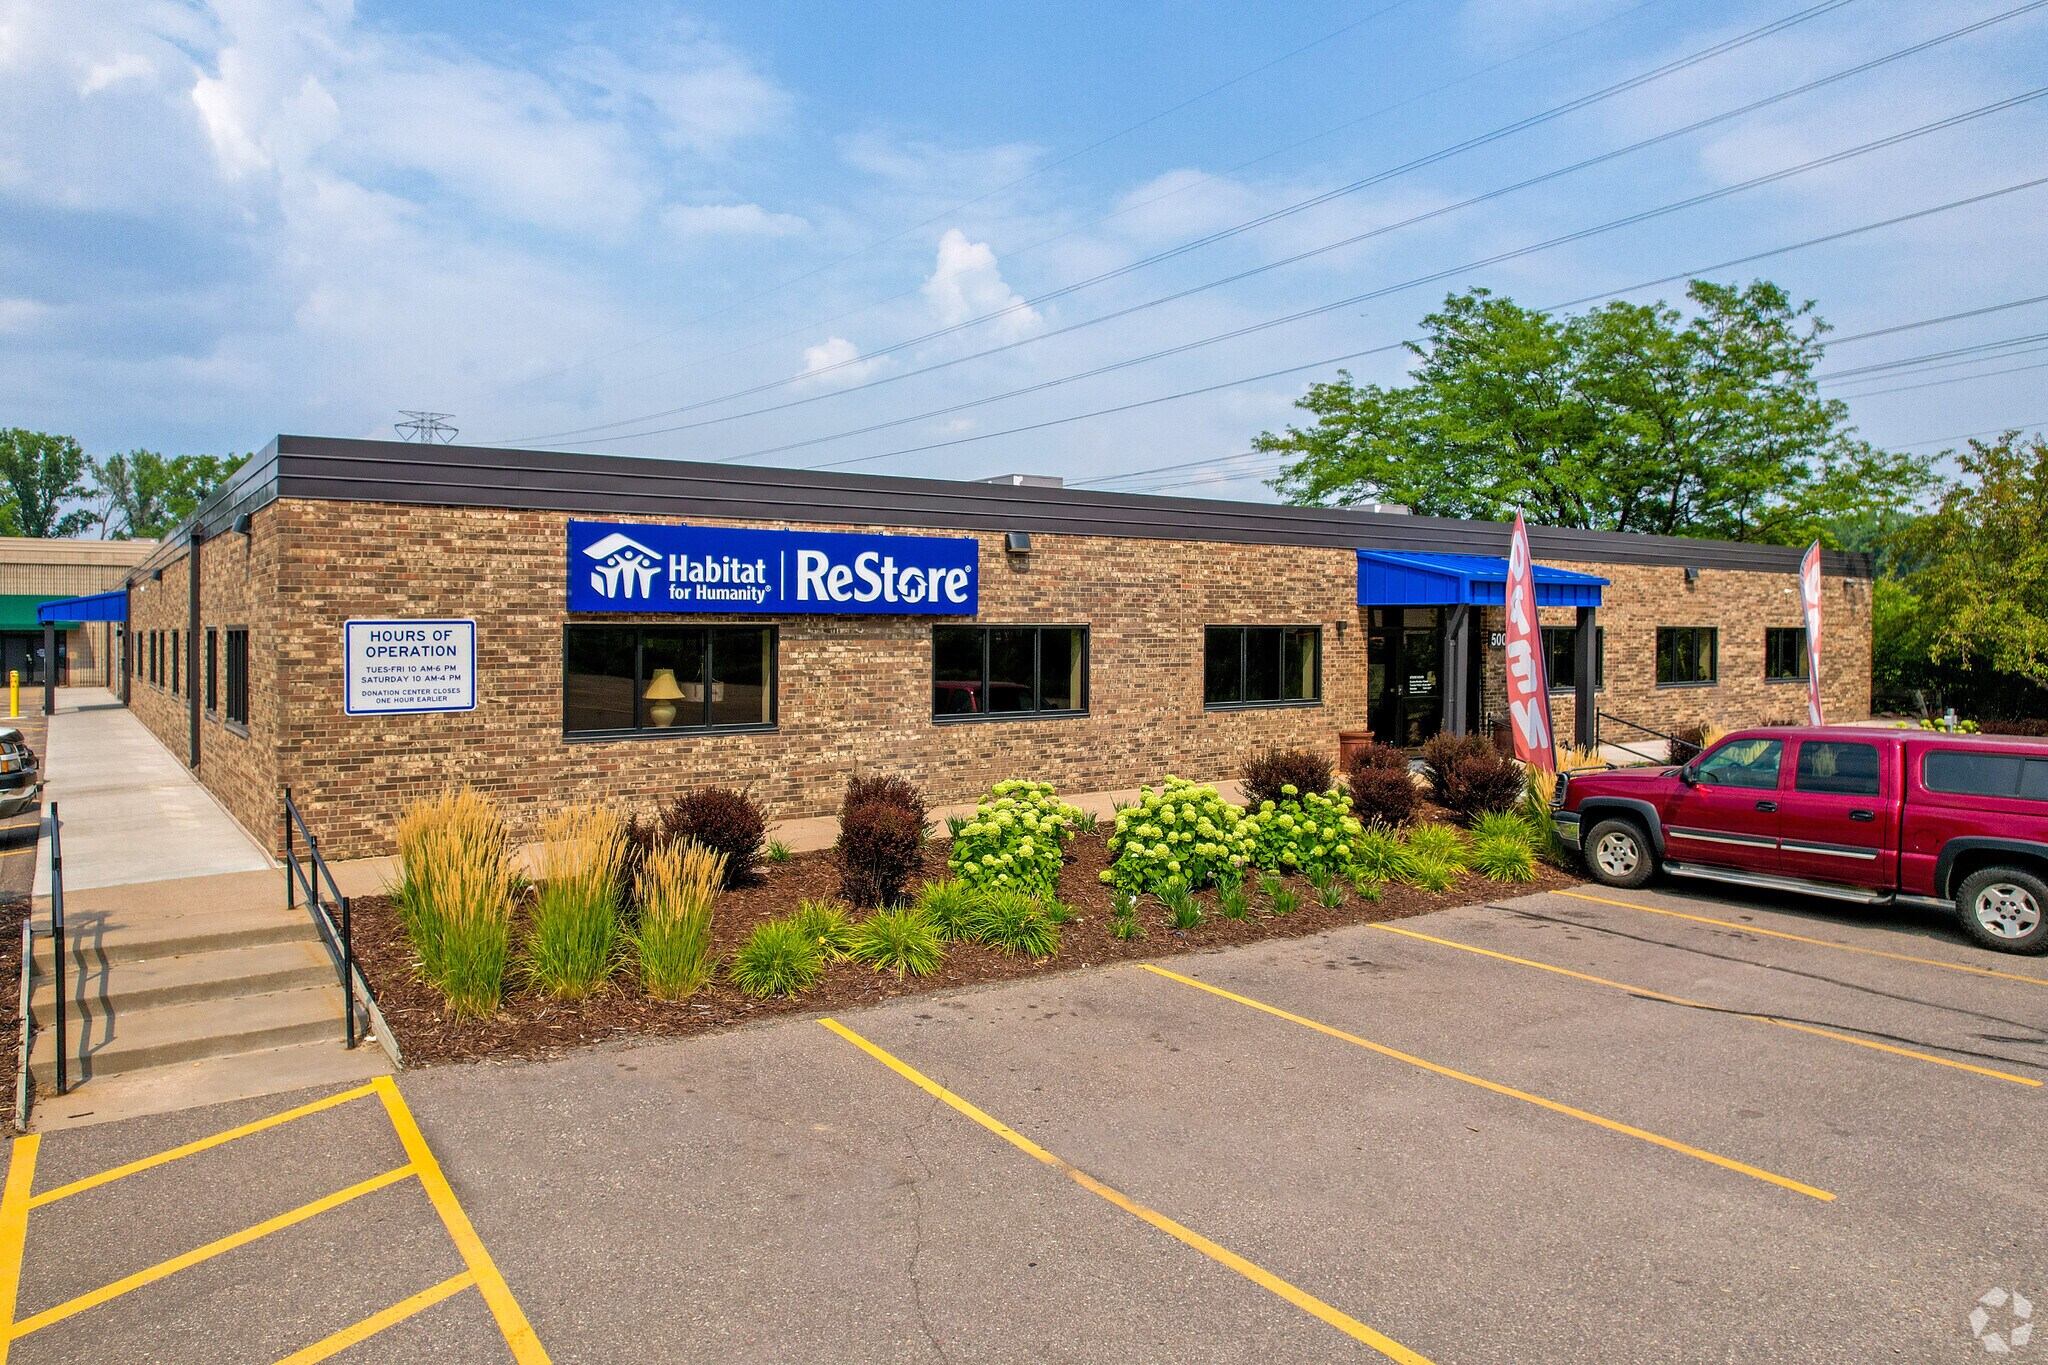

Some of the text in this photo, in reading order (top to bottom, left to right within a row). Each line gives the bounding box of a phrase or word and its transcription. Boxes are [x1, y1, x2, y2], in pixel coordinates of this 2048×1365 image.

[669, 554, 766, 584] Habitat
[669, 583, 691, 600] for
[370, 630, 453, 642] HOURS OF
[366, 645, 457, 658] OPERATION
